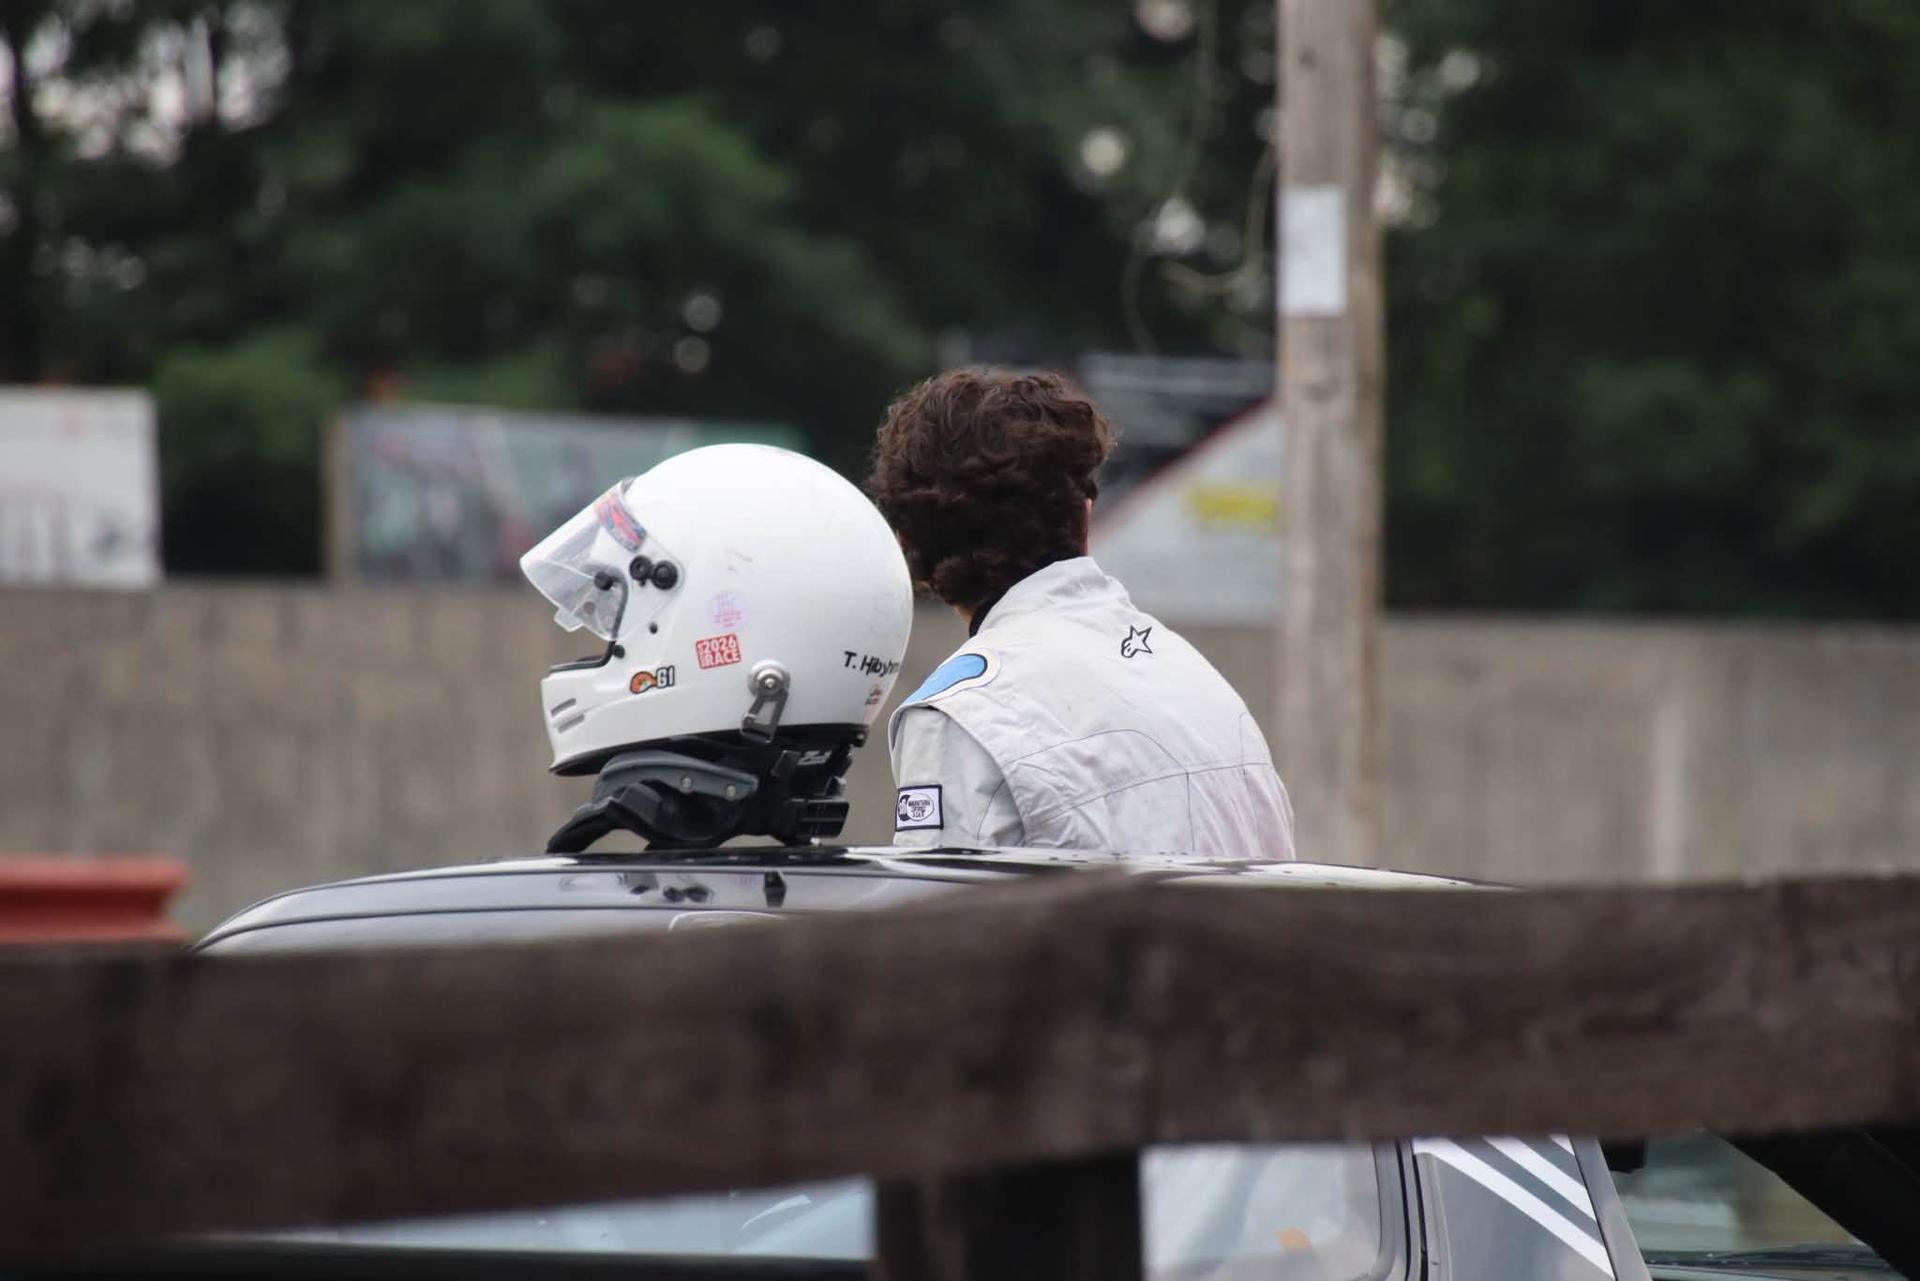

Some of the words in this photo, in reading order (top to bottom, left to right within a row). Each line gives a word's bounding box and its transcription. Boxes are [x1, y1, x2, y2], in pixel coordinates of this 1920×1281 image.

[703, 635, 737, 654] 2026
[704, 648, 740, 667] RACE
[844, 650, 857, 669] T.
